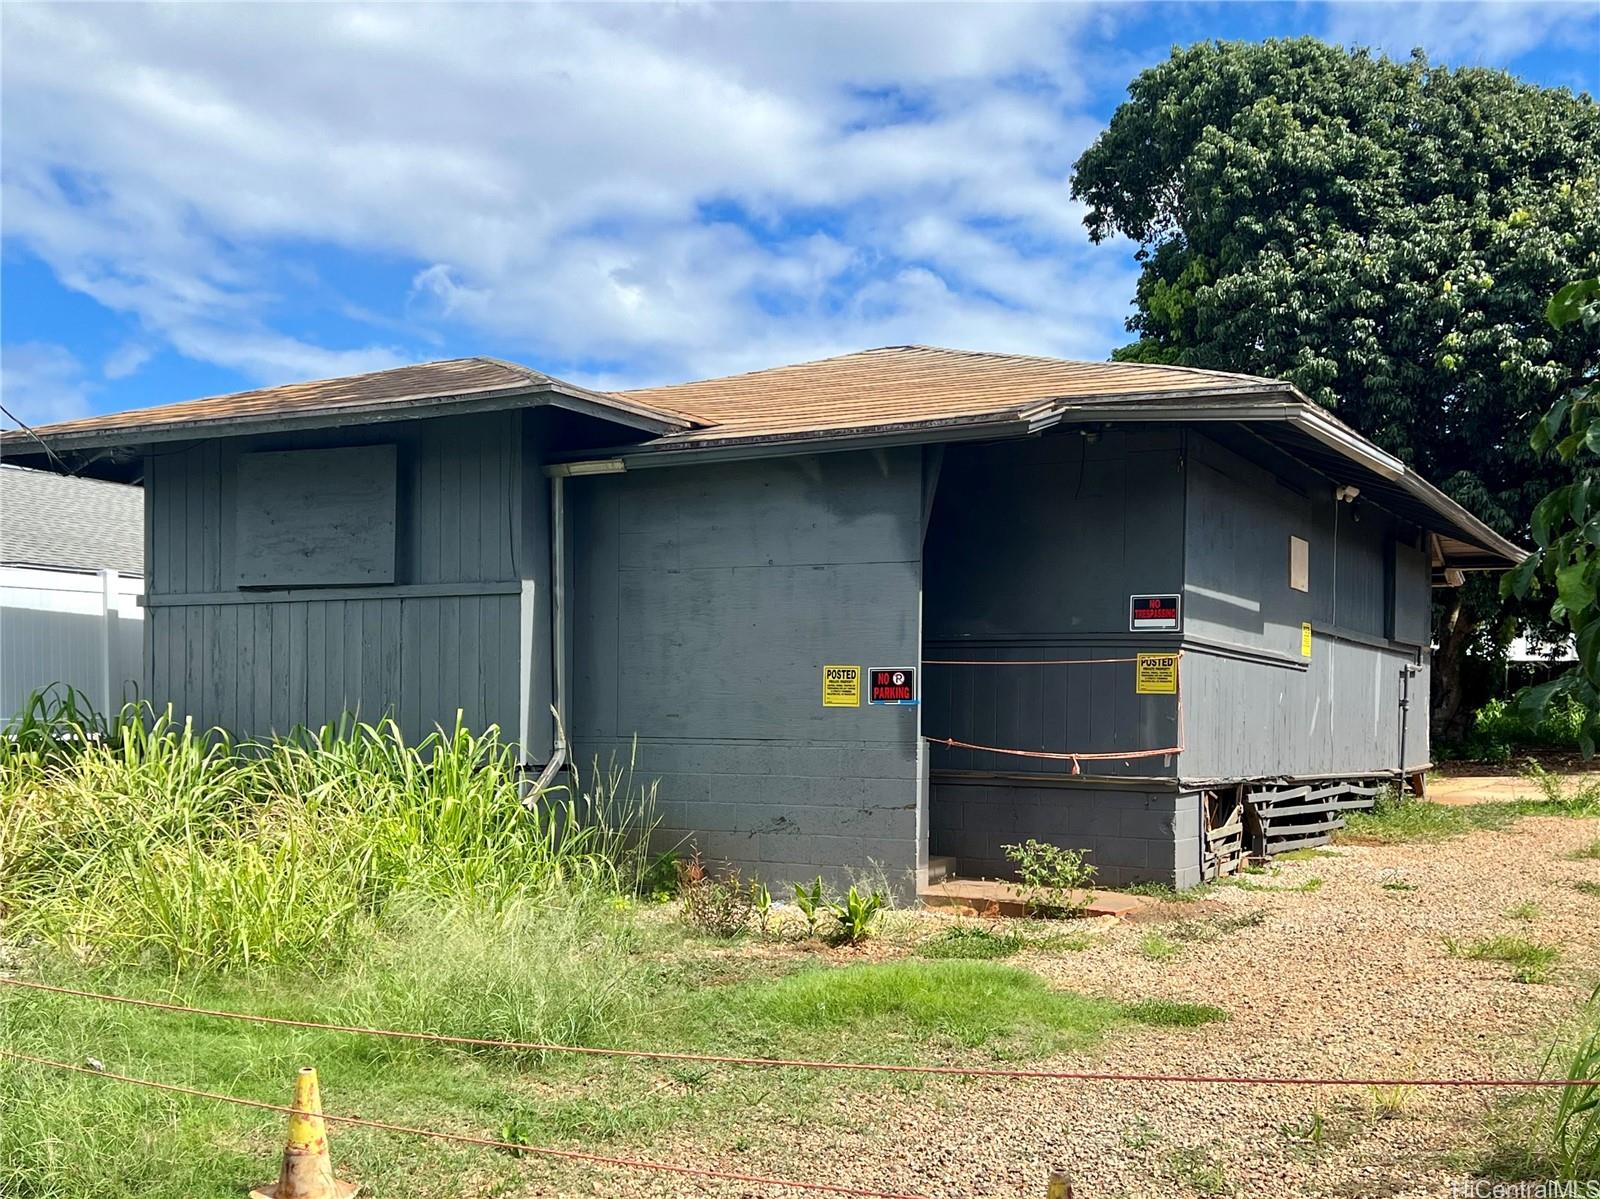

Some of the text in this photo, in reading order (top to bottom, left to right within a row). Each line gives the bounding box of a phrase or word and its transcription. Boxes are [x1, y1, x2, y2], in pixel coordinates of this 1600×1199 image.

[1149, 599, 1161, 609] NO
[1134, 608, 1176, 618] TRESPASSING
[1141, 657, 1173, 667] POSTED
[826, 669, 857, 680] POSTED
[878, 672, 890, 685] NO
[873, 686, 910, 699] PARKING
